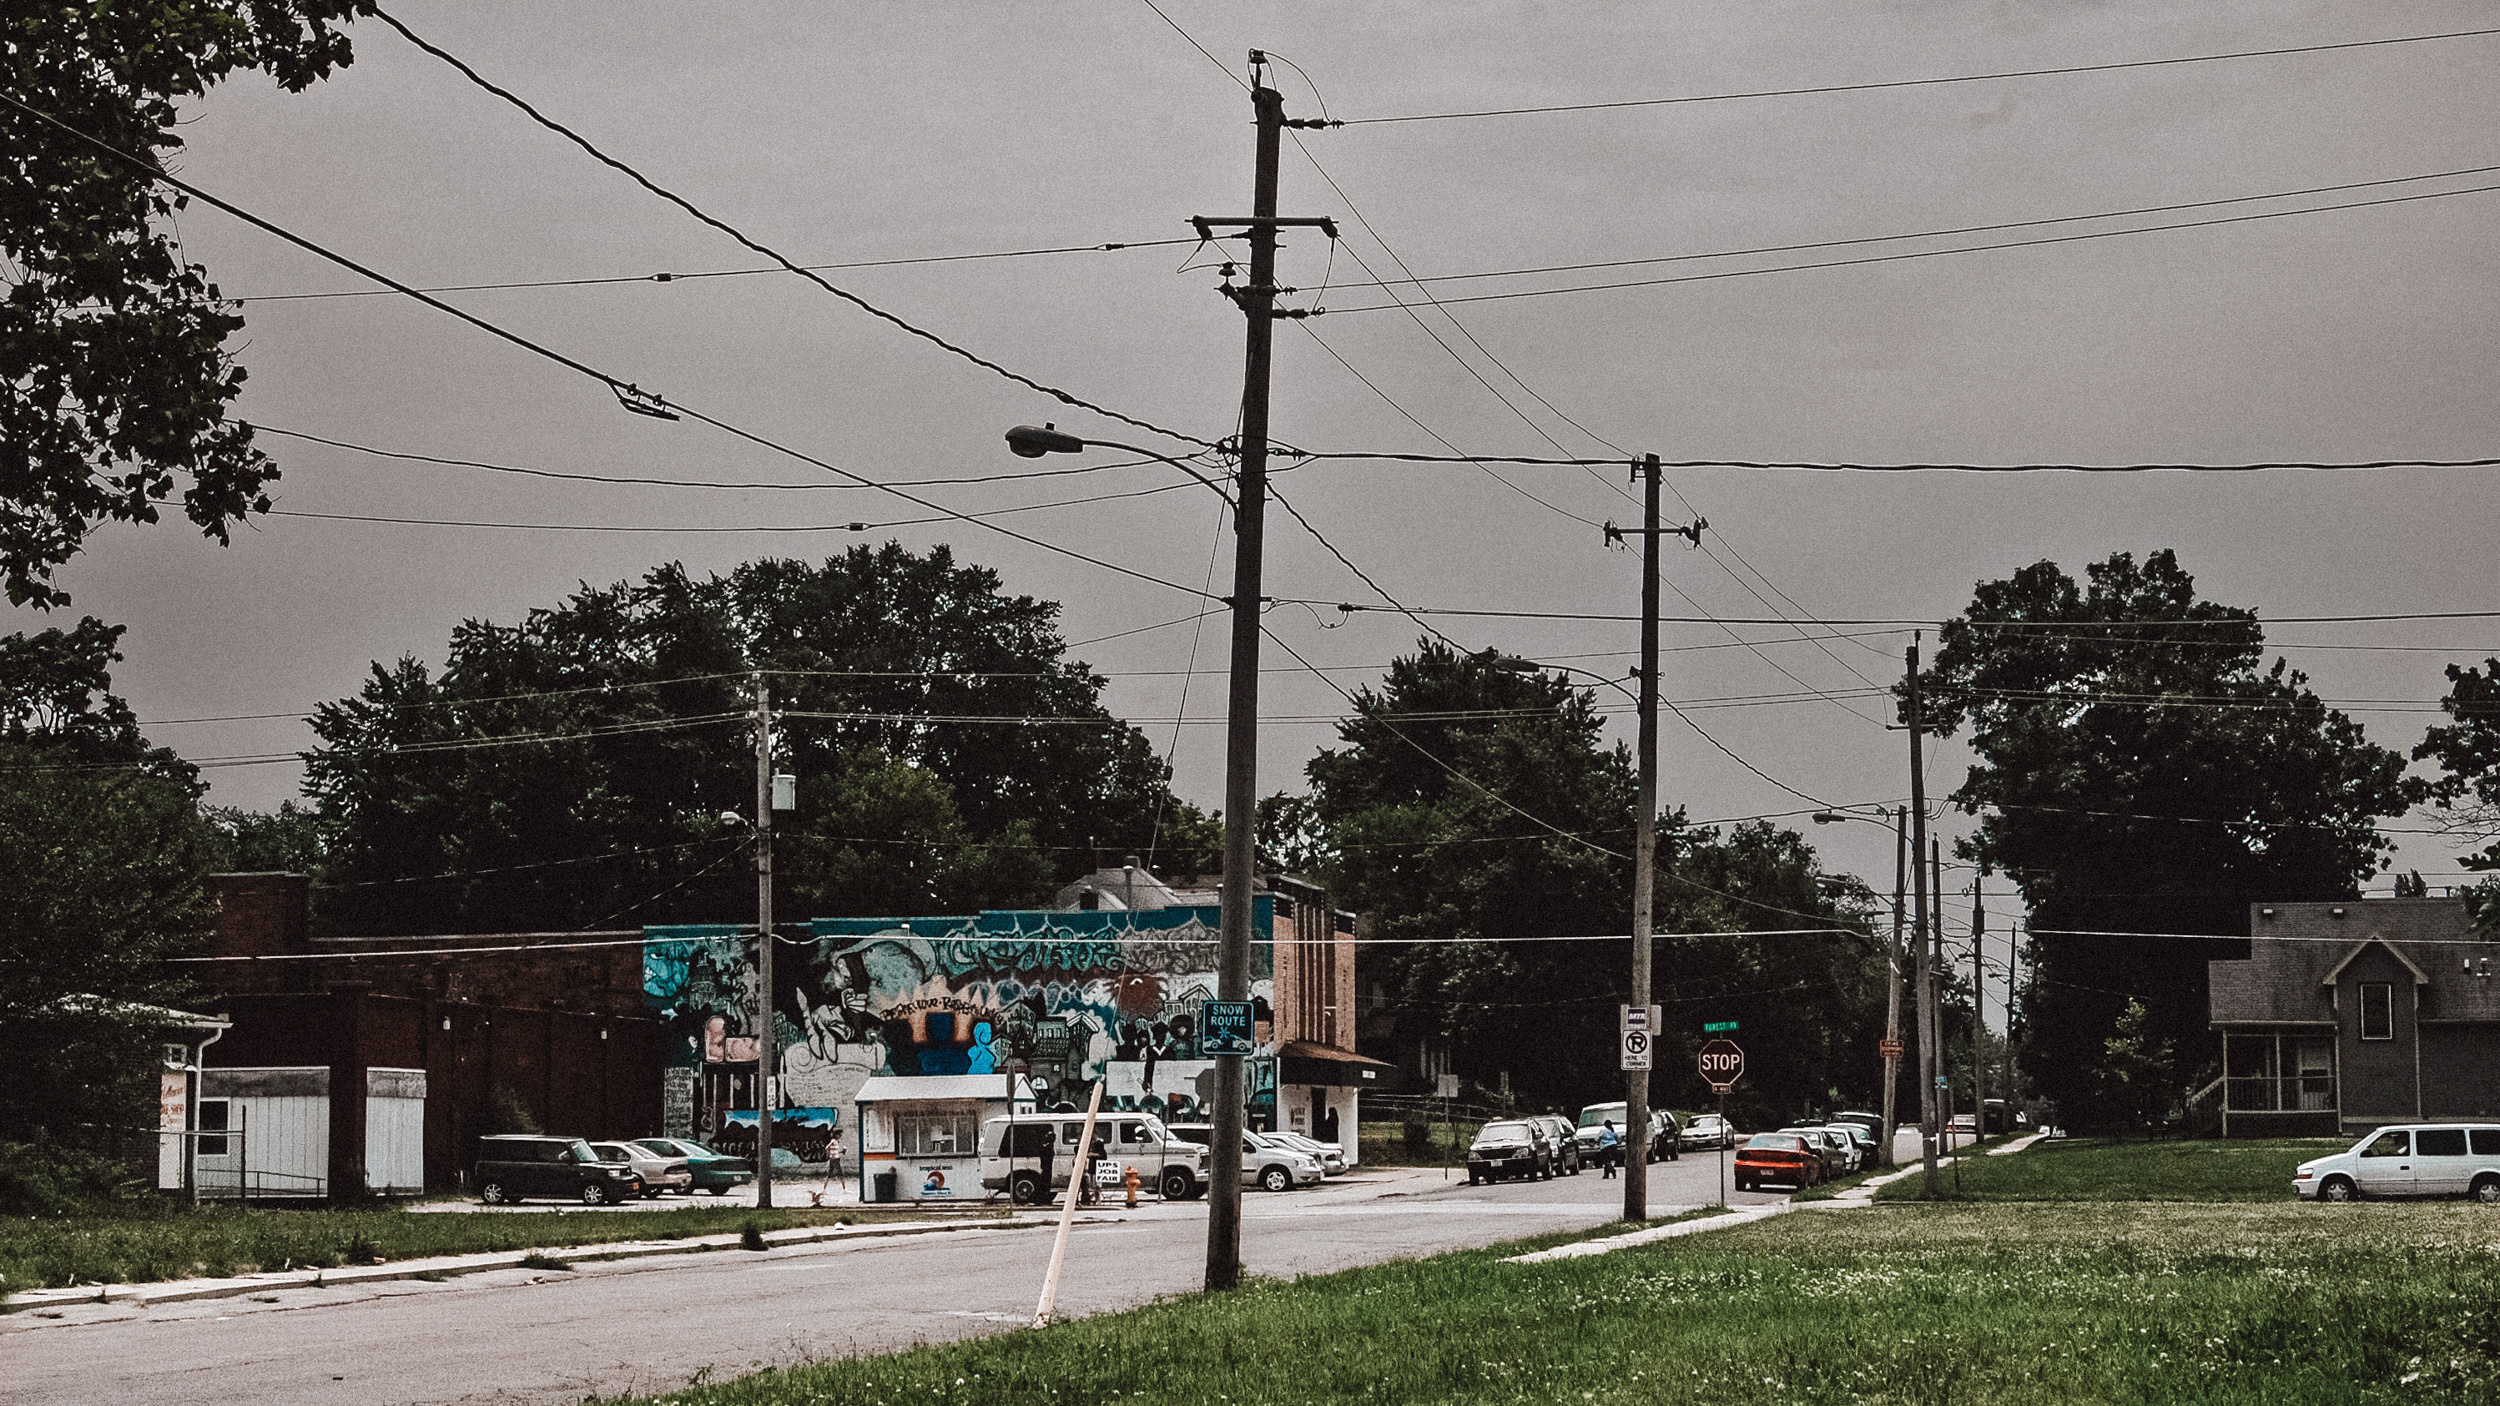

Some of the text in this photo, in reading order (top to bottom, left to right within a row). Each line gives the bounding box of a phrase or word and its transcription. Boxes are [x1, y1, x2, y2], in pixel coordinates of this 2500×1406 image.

[1212, 1004, 1245, 1016] SNOW
[1210, 1016, 1246, 1027] ROUTE
[1702, 1054, 1740, 1071] STOP
